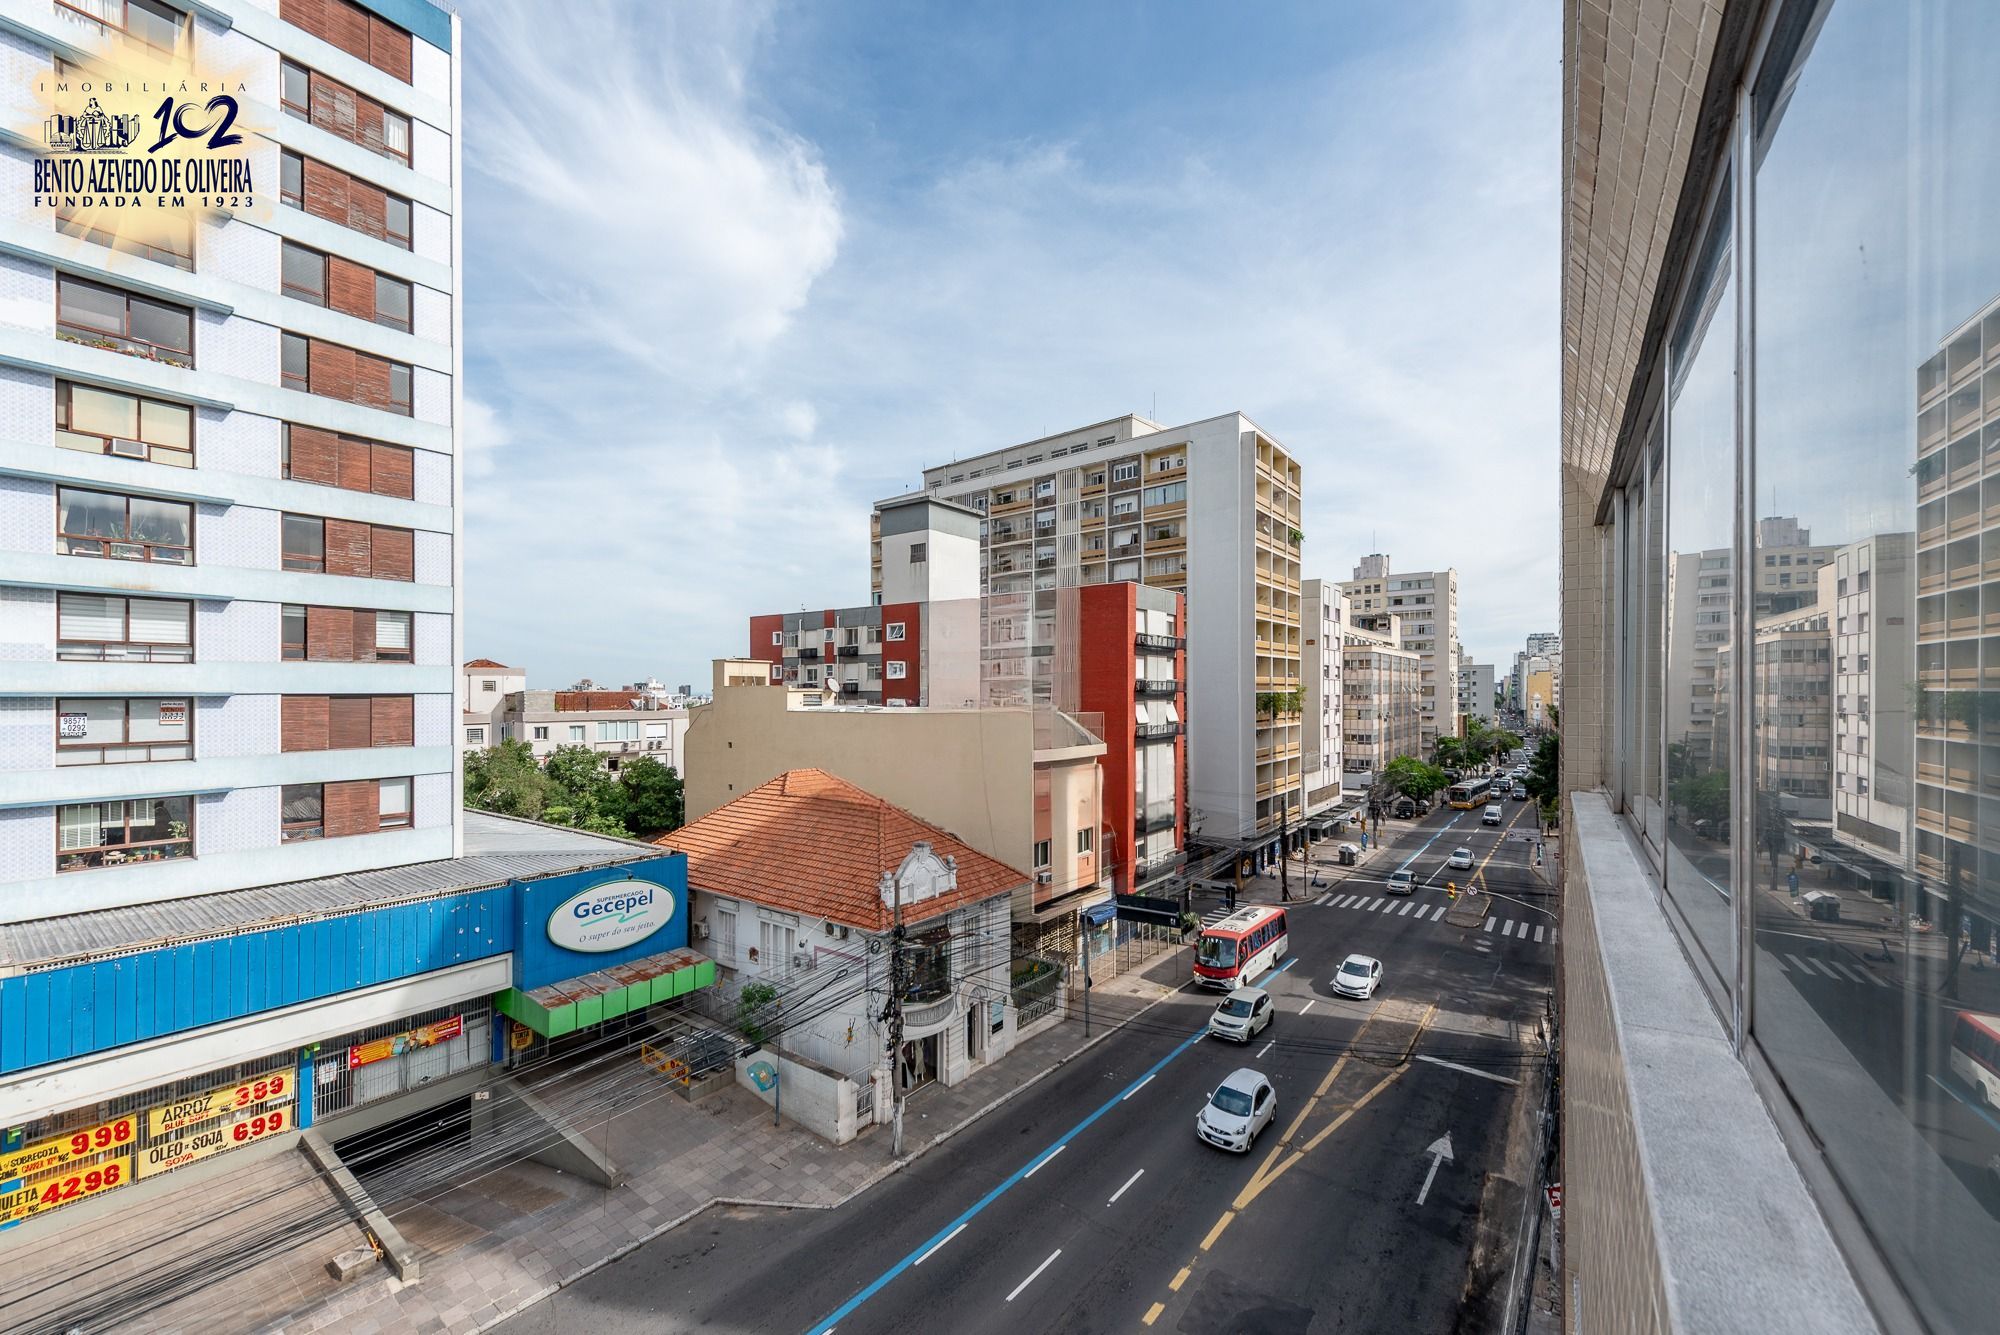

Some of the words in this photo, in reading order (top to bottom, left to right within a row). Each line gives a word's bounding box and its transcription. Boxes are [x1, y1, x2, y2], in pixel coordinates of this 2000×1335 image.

[63, 717, 86, 725] 98571
[67, 724, 86, 732] 0292
[573, 889, 653, 919] Gecepel
[596, 890, 644, 903] SUPERMERCADO
[579, 935, 586, 943] O
[588, 930, 610, 942] super
[611, 927, 622, 936] do
[622, 925, 636, 933] seu
[235, 1075, 284, 1106] 3.89
[161, 1096, 213, 1125] ARROZ
[71, 1120, 131, 1155] 9.98
[165, 1118, 185, 1132] BLUE
[233, 1112, 283, 1142] 6.99
[10, 1146, 59, 1168] SOBRECOXA
[150, 1141, 183, 1164] ÓLEO
[192, 1130, 223, 1151] SOJA
[165, 1152, 194, 1168] SOYA
[40, 1165, 121, 1204] 42.98
